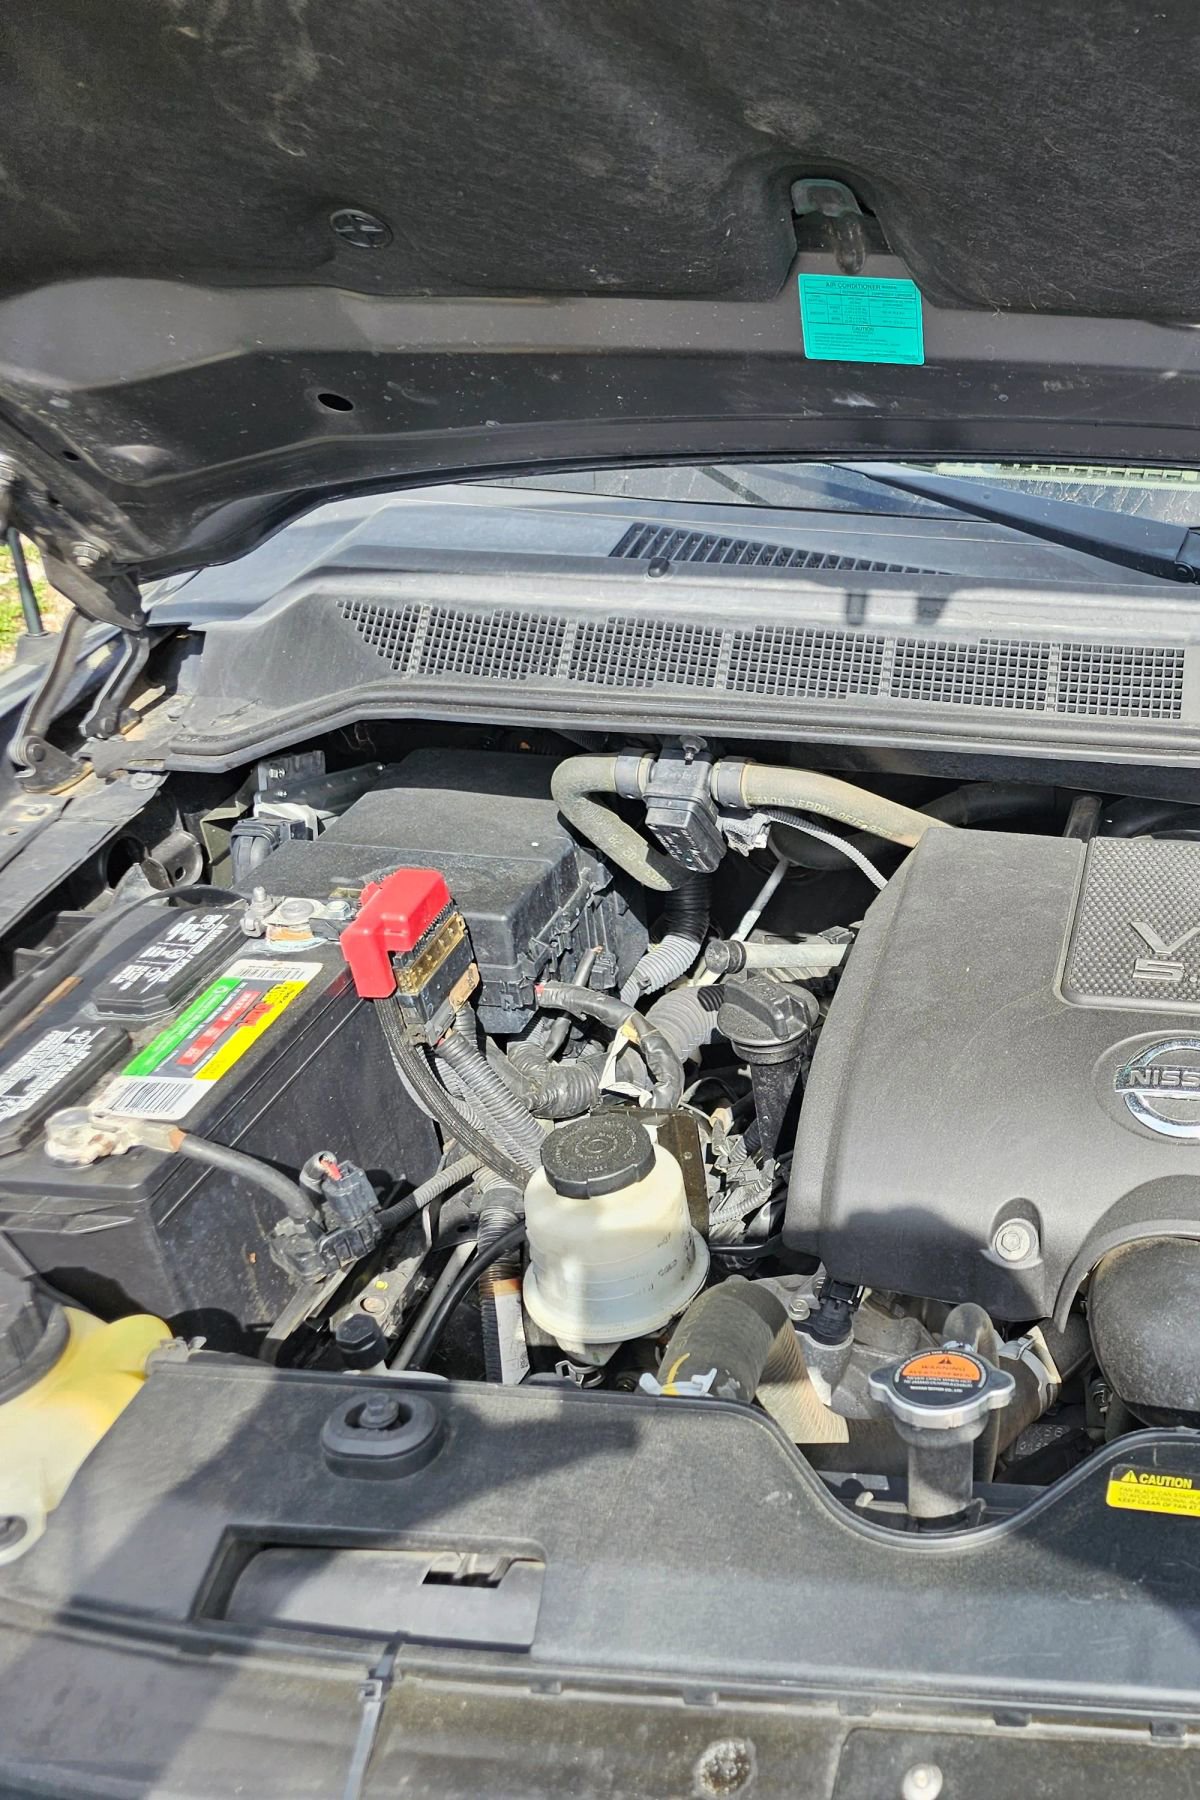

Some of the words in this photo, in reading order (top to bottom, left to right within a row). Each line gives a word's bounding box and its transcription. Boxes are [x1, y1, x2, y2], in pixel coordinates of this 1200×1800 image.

[838, 283, 881, 291] CONDITIONER
[1138, 1473, 1193, 1489] CAUTION
[1157, 1489, 1173, 1497] CAN
[1173, 1491, 1196, 1500] START
[1137, 1498, 1162, 1507] CLEAR
